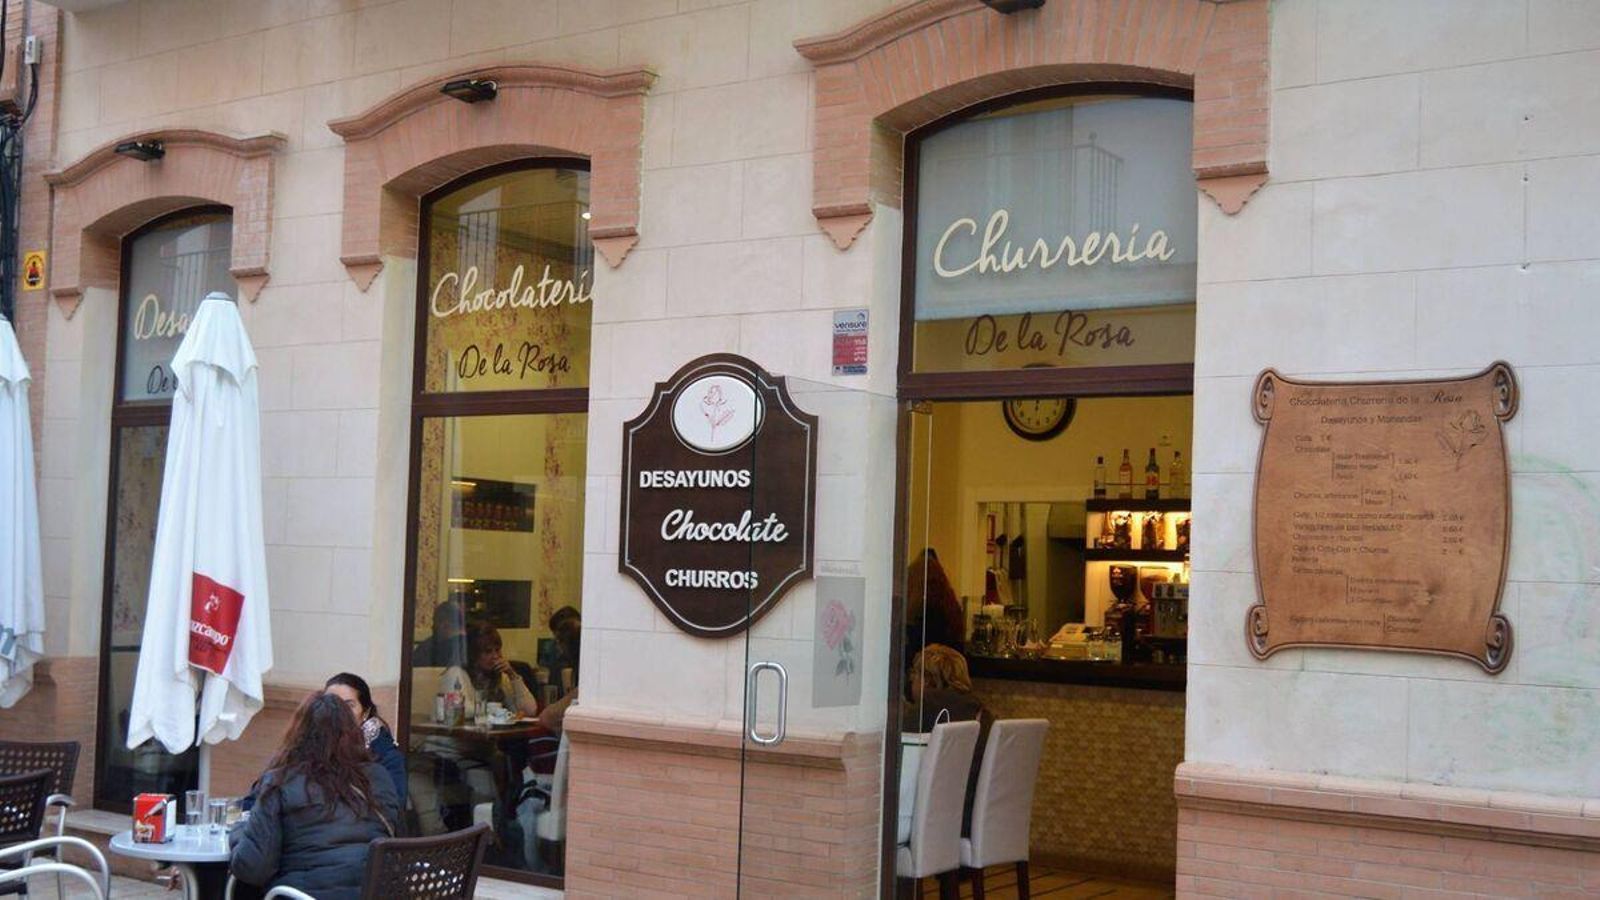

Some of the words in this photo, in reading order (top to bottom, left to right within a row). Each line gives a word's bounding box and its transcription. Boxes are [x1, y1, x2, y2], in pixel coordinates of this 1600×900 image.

[933, 208, 1176, 278] Churrería
[431, 264, 595, 318] Chocolaterí
[134, 293, 191, 340] Desa
[965, 313, 1008, 356] De
[1017, 311, 1048, 351] la
[1054, 309, 1135, 356] Rosa
[458, 344, 488, 380] De
[493, 342, 514, 376] la
[518, 341, 571, 380] Rosa
[147, 364, 168, 395] De
[639, 469, 752, 489] DESAYUNOS
[660, 508, 790, 543] Chocolate
[665, 568, 759, 590] CHURROS
[190, 620, 231, 646] uzcampo
